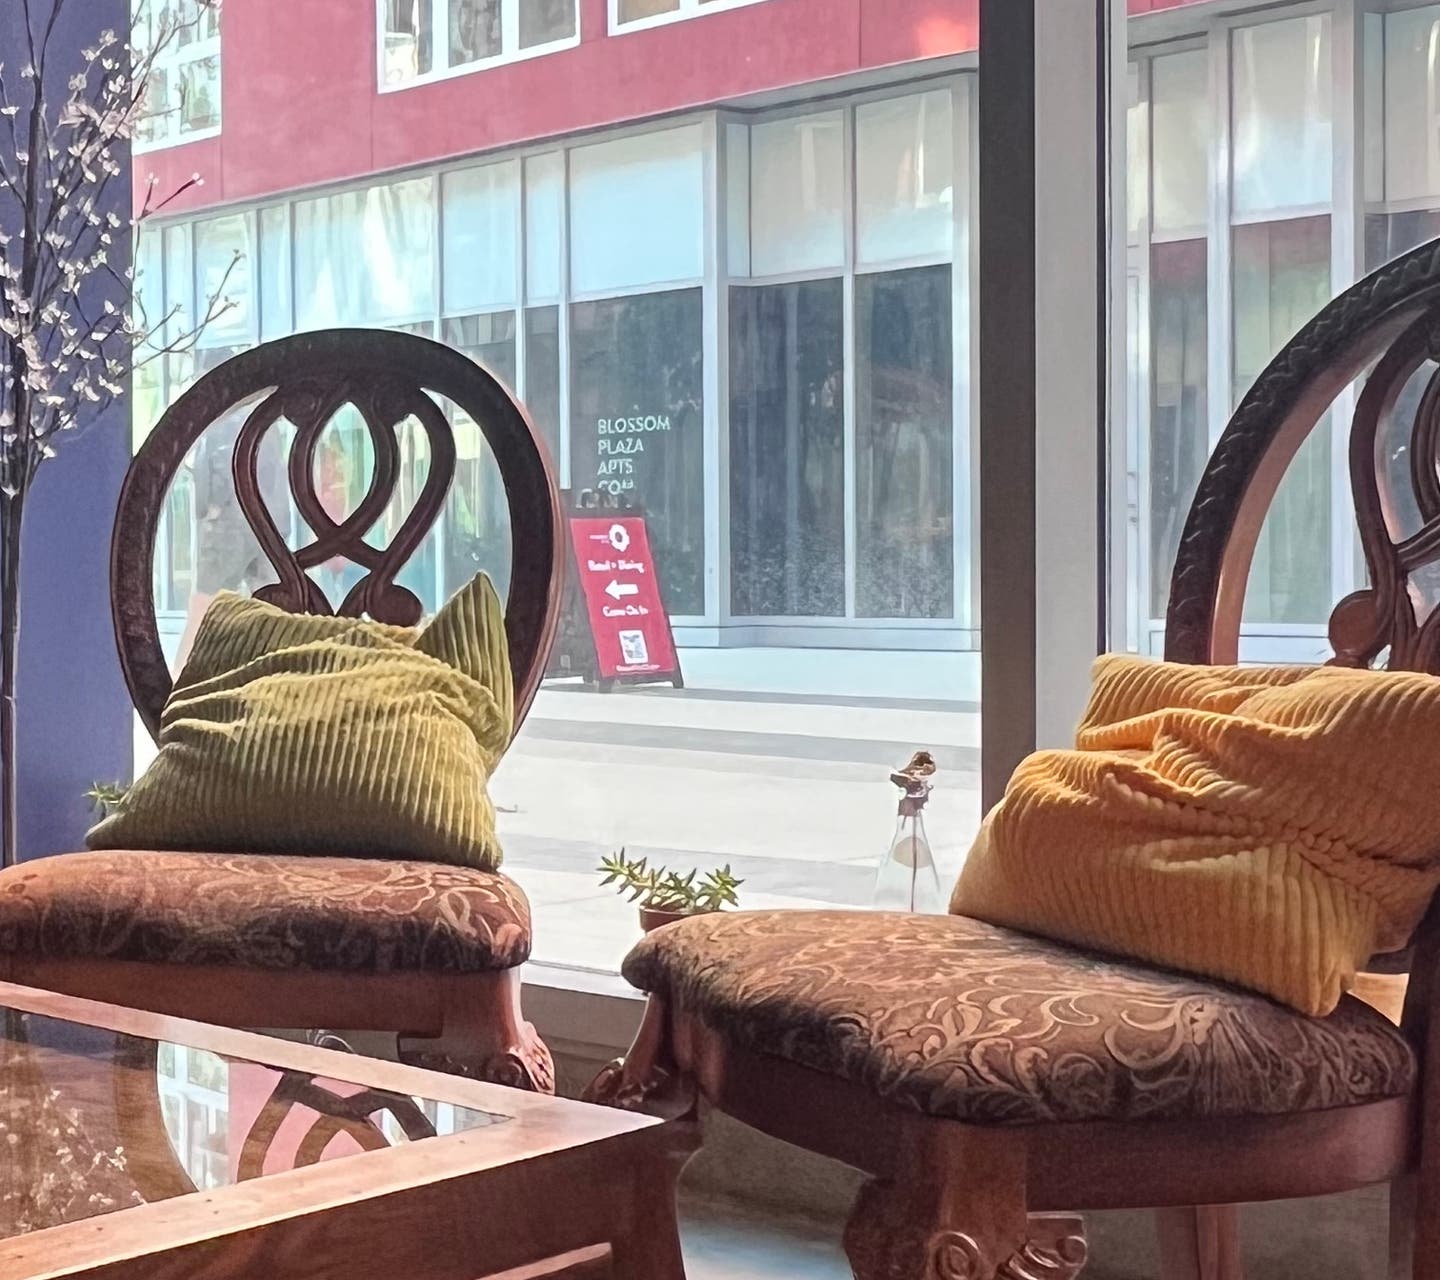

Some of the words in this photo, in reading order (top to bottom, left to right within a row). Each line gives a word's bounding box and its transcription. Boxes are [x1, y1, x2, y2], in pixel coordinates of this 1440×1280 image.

[597, 415, 671, 435] BLOSSOM
[597, 438, 644, 455] PLAZA
[597, 458, 633, 475] APTS
